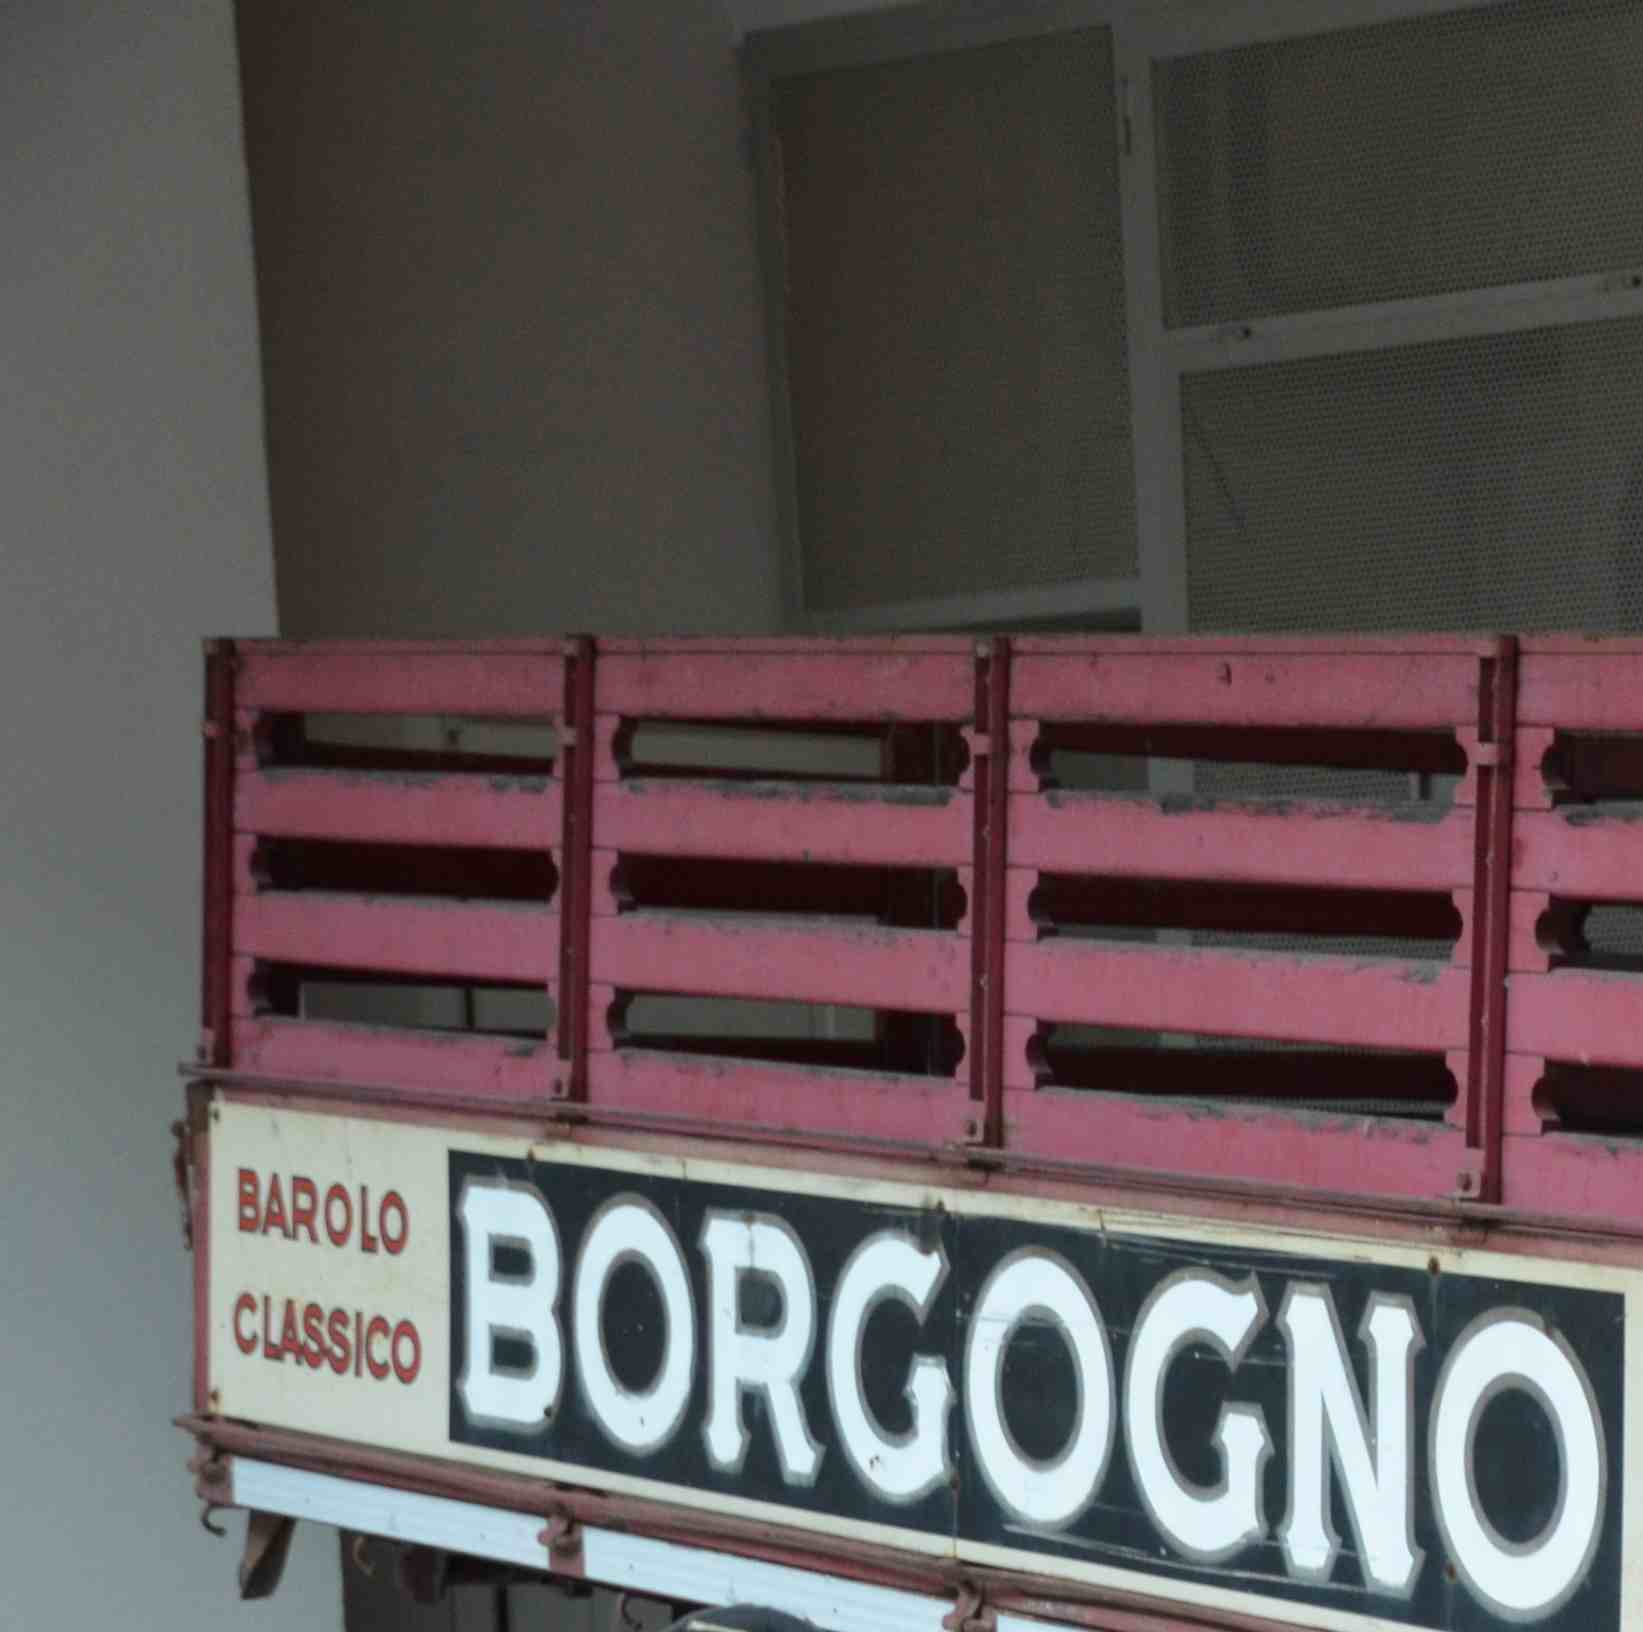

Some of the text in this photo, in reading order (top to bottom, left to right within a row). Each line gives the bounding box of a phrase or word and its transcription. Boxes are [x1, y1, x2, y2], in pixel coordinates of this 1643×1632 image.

[237, 1166, 410, 1256] BAROLO
[233, 1291, 422, 1385] CLASSICO
[455, 1173, 1607, 1624] BORGOGNO
